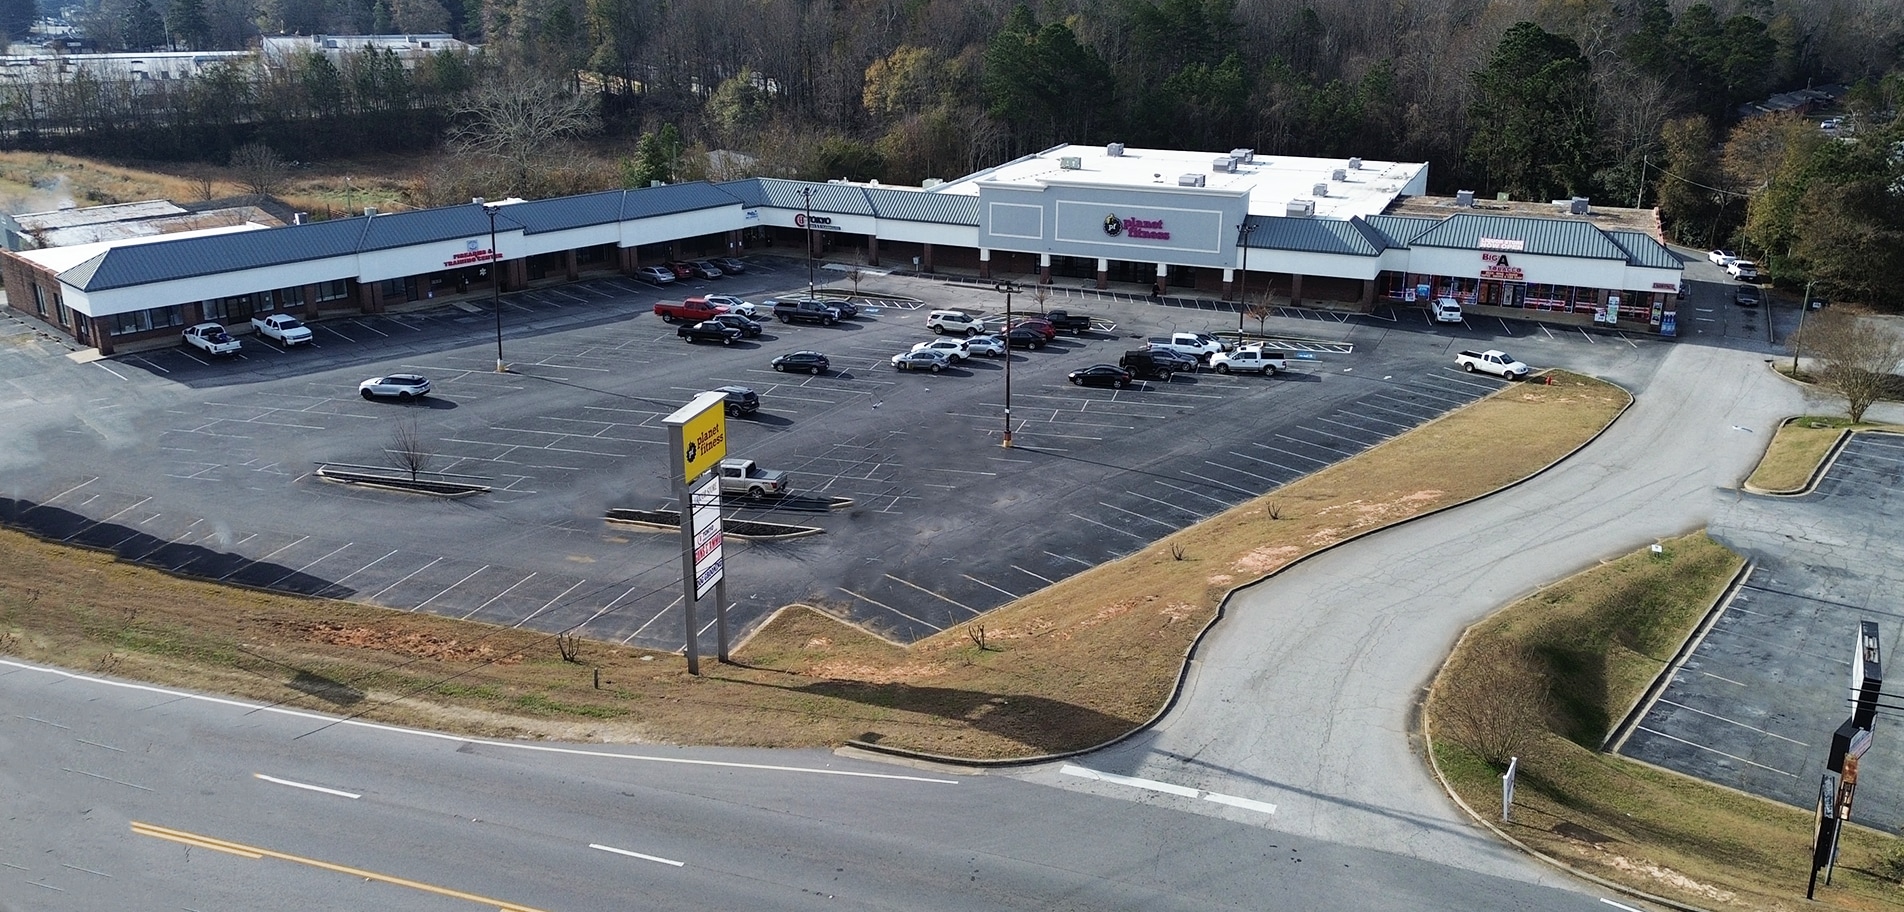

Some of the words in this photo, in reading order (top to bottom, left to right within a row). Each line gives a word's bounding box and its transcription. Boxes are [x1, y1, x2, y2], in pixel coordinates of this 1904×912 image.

[1123, 216, 1163, 230] planet
[1128, 227, 1170, 240] fitness
[443, 257, 477, 267] TRAINING
[477, 253, 503, 261] CENTER
[453, 250, 486, 259] FIREARMS
[1496, 255, 1508, 266] A
[697, 423, 719, 449] planet
[700, 433, 724, 456] fitness
